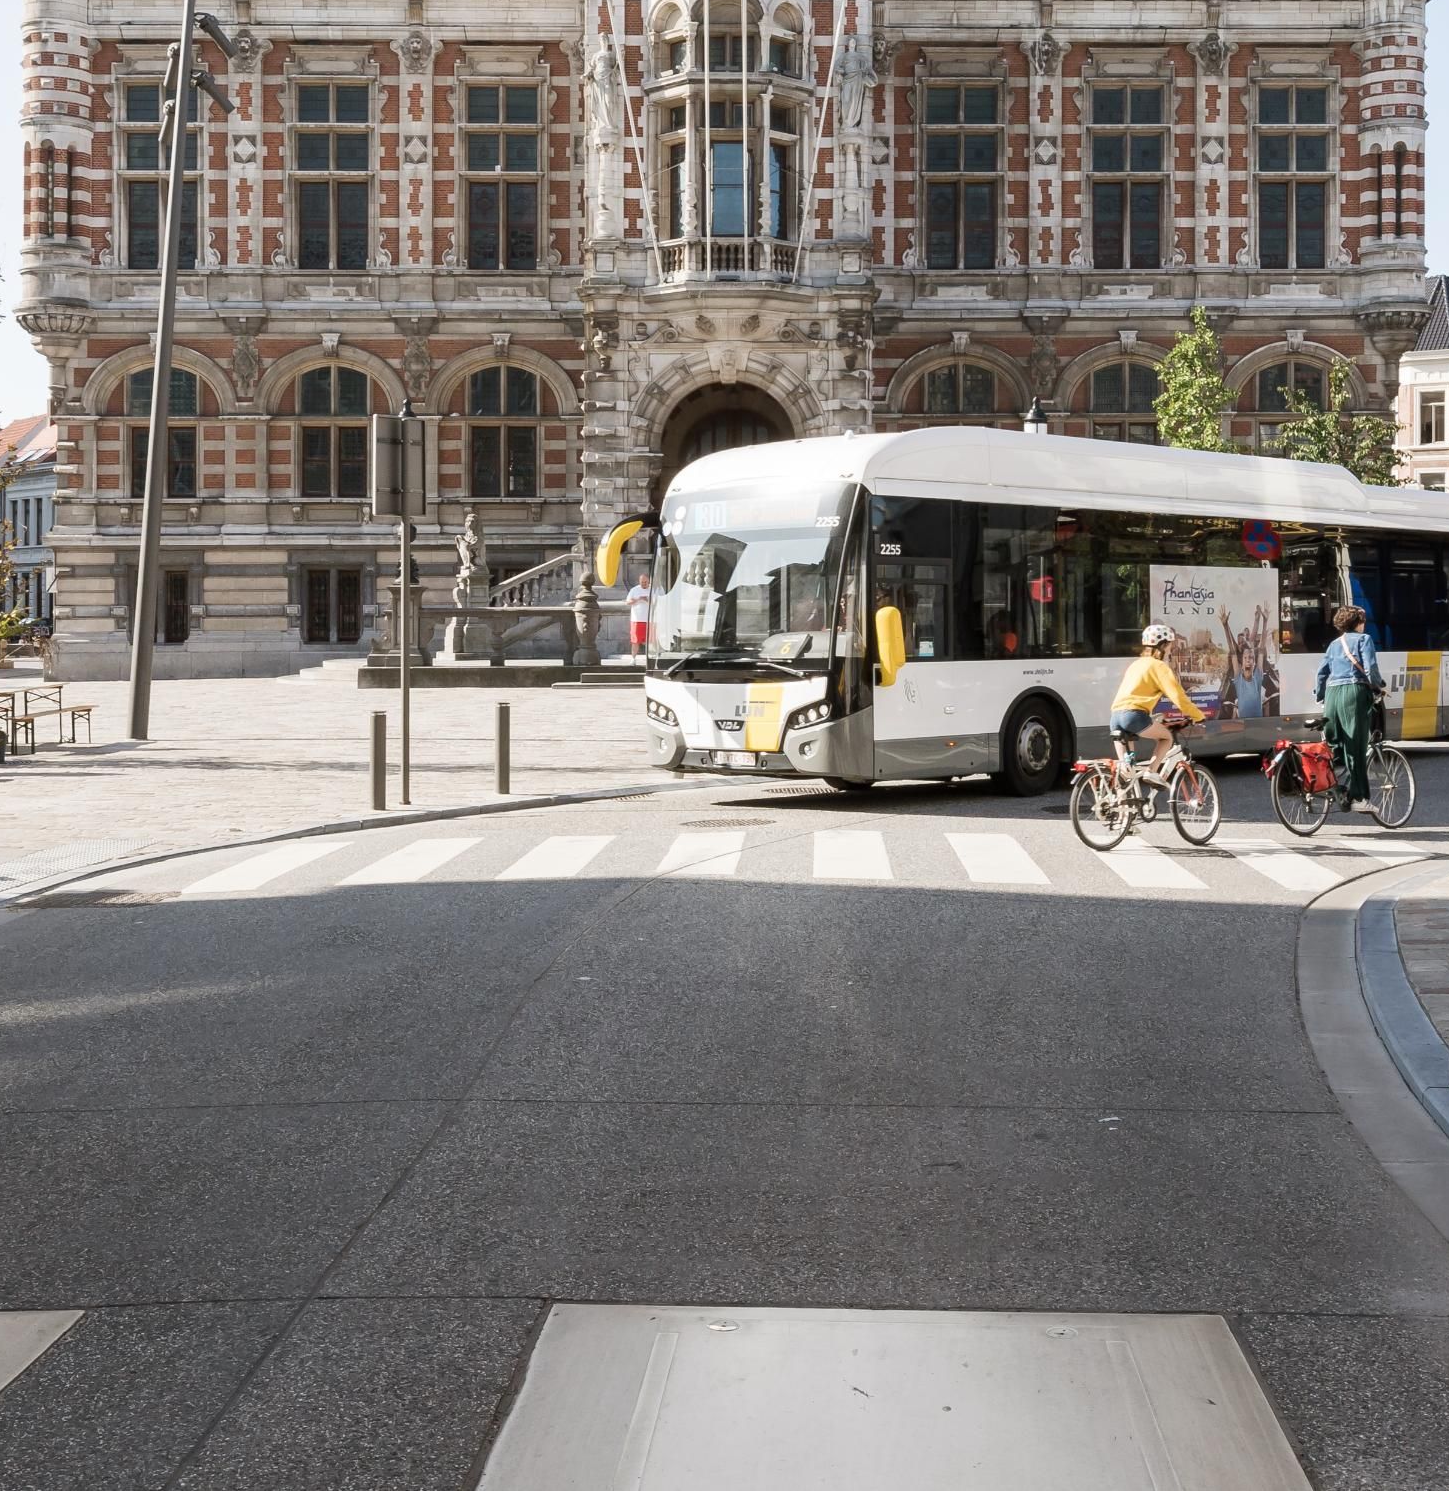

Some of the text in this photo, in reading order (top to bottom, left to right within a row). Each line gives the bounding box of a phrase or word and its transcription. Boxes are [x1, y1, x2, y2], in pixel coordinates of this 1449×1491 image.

[815, 515, 840, 527] 2255
[880, 543, 901, 555] 2255
[1163, 573, 1215, 606] Phantasia
[1163, 607, 1215, 615] LAND
[717, 721, 741, 730] VDL
